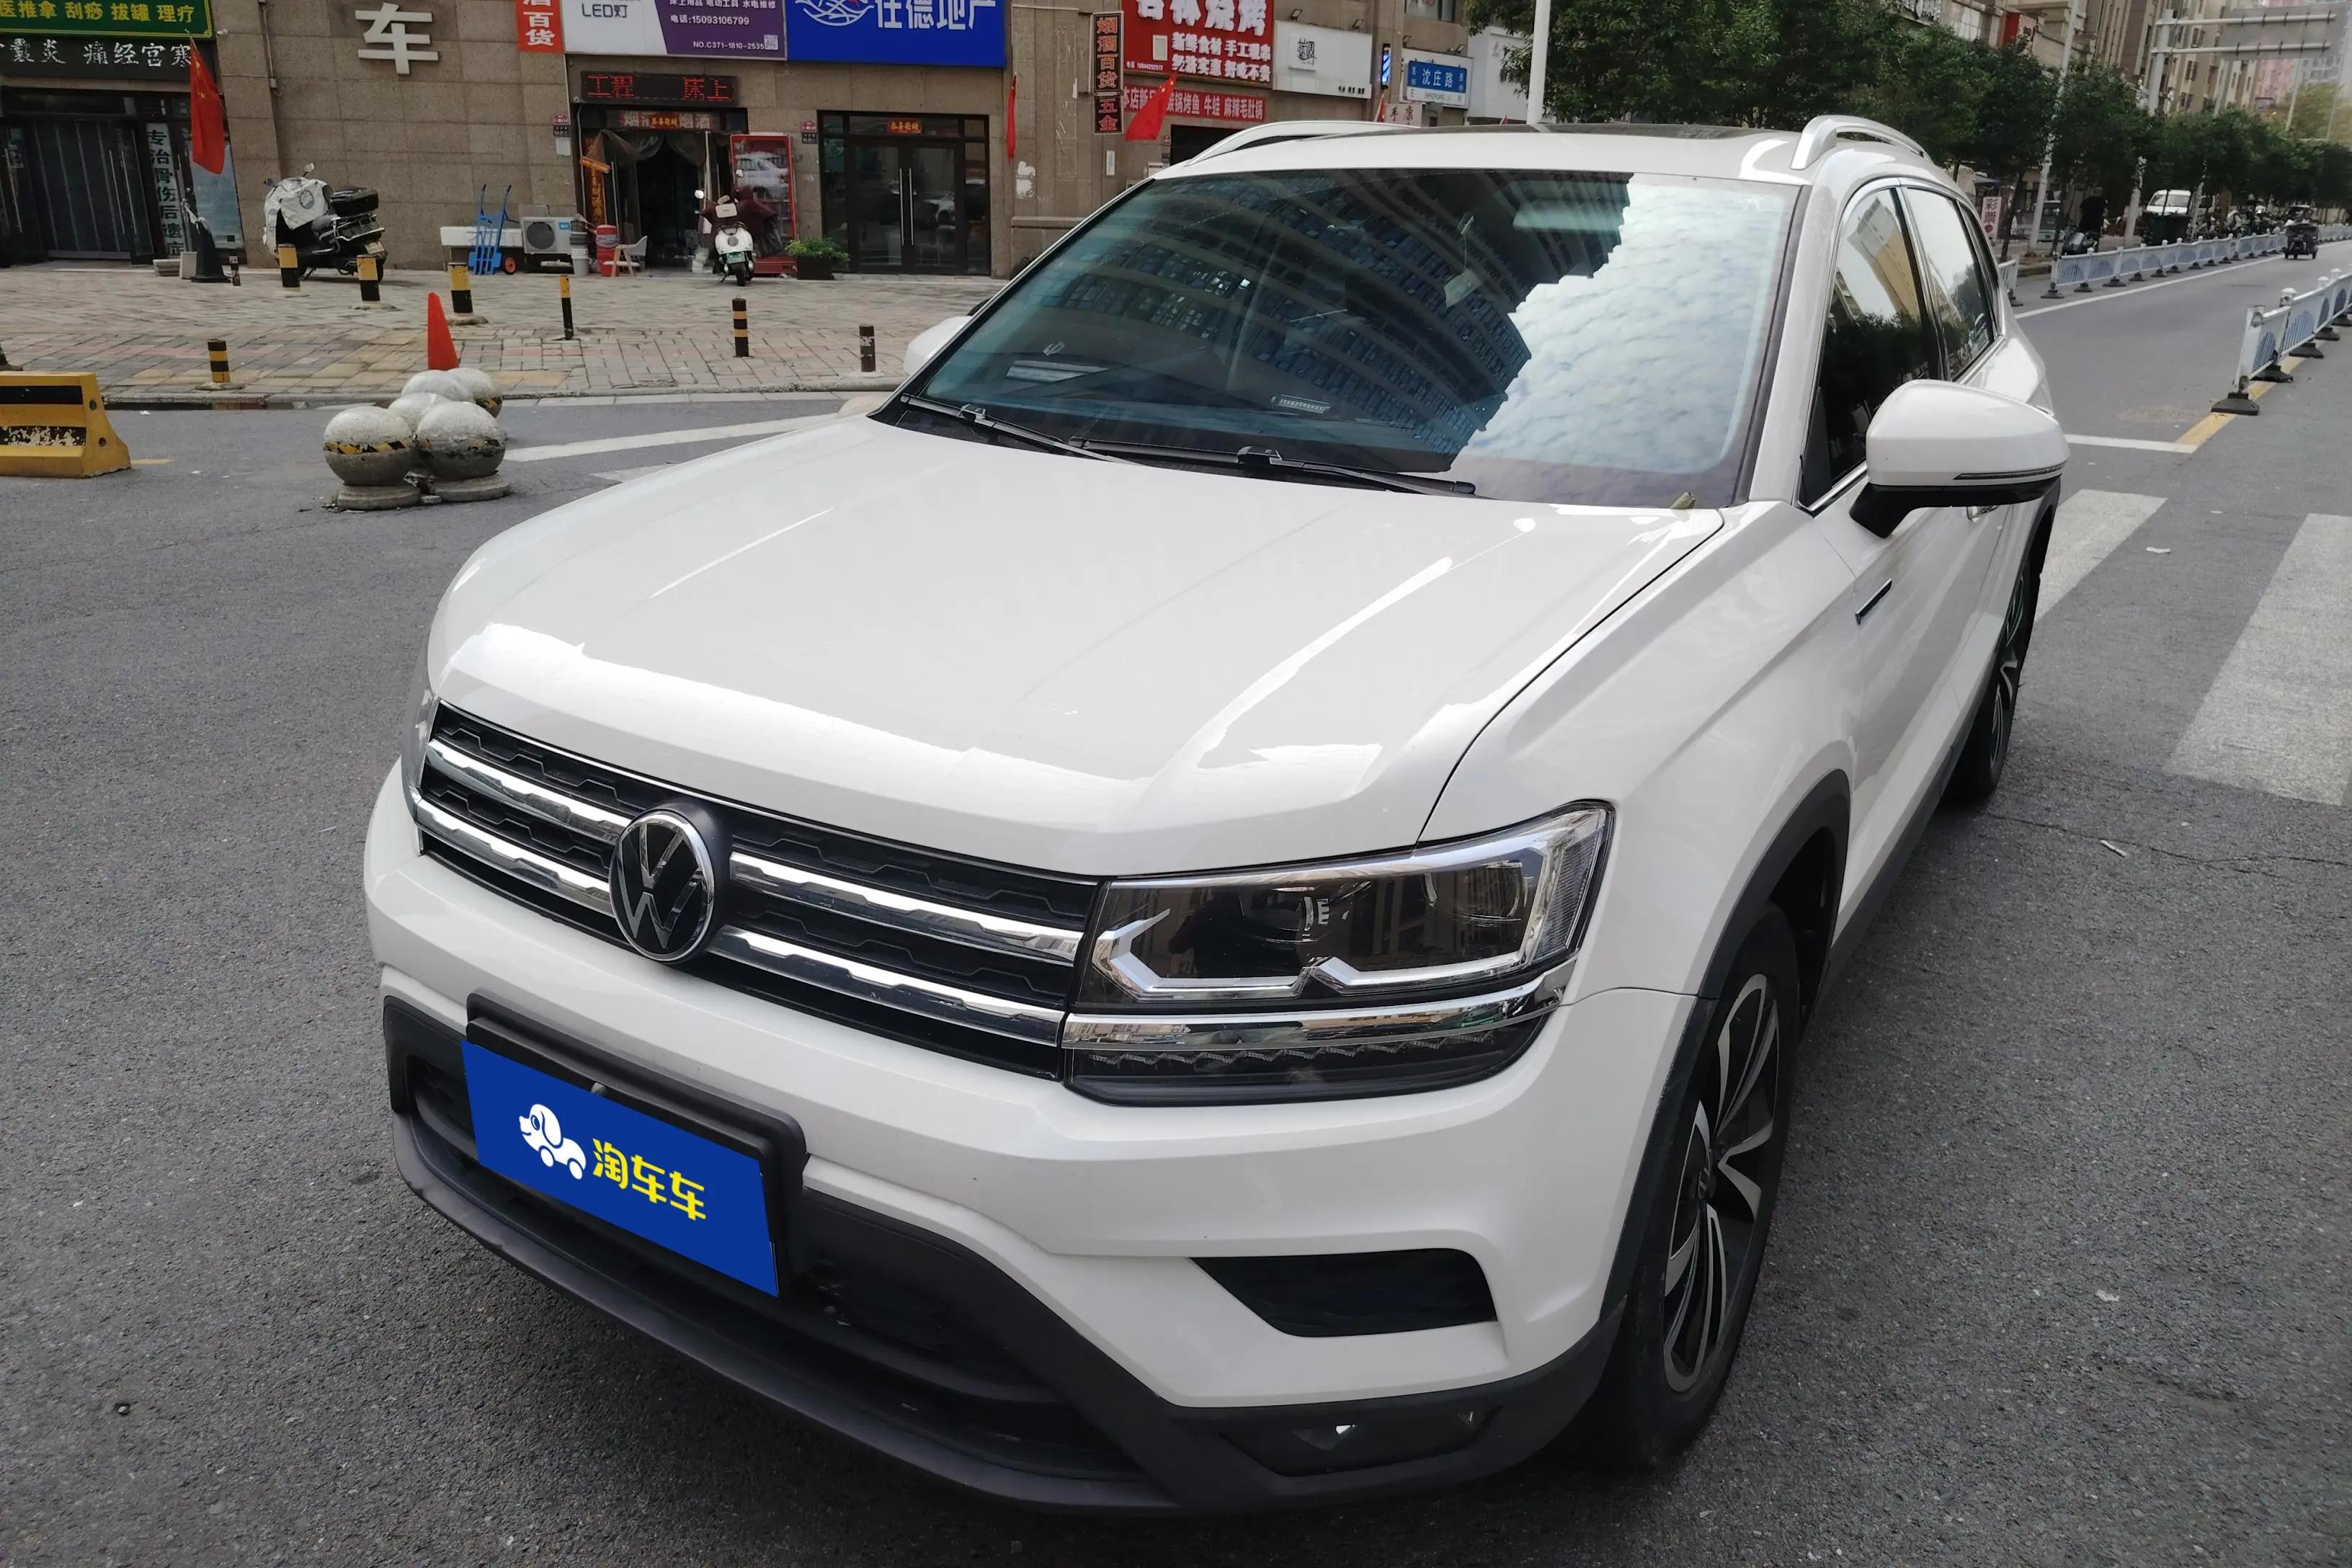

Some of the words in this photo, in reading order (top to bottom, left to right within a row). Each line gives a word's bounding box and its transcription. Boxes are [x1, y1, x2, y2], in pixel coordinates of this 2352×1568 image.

[64, 1, 103, 20] 刮痧
[110, 3, 151, 22] 拔罐
[156, 4, 195, 23] 理疗
[582, 3, 628, 18] LED灯
[670, 14, 750, 25] 电话:15093106799
[355, 3, 438, 74] 车
[1172, 32, 1222, 55] 新鲜食材
[0, 38, 66, 64] 囊炎
[1096, 17, 1118, 89] 烟酒百货
[1172, 54, 1222, 76] 经济实惠
[1224, 60, 1271, 82] 好吃不贵
[1422, 68, 1453, 88] 沈庄路
[1098, 99, 1118, 132] 五金
[1204, 95, 1221, 116] 牛蛙
